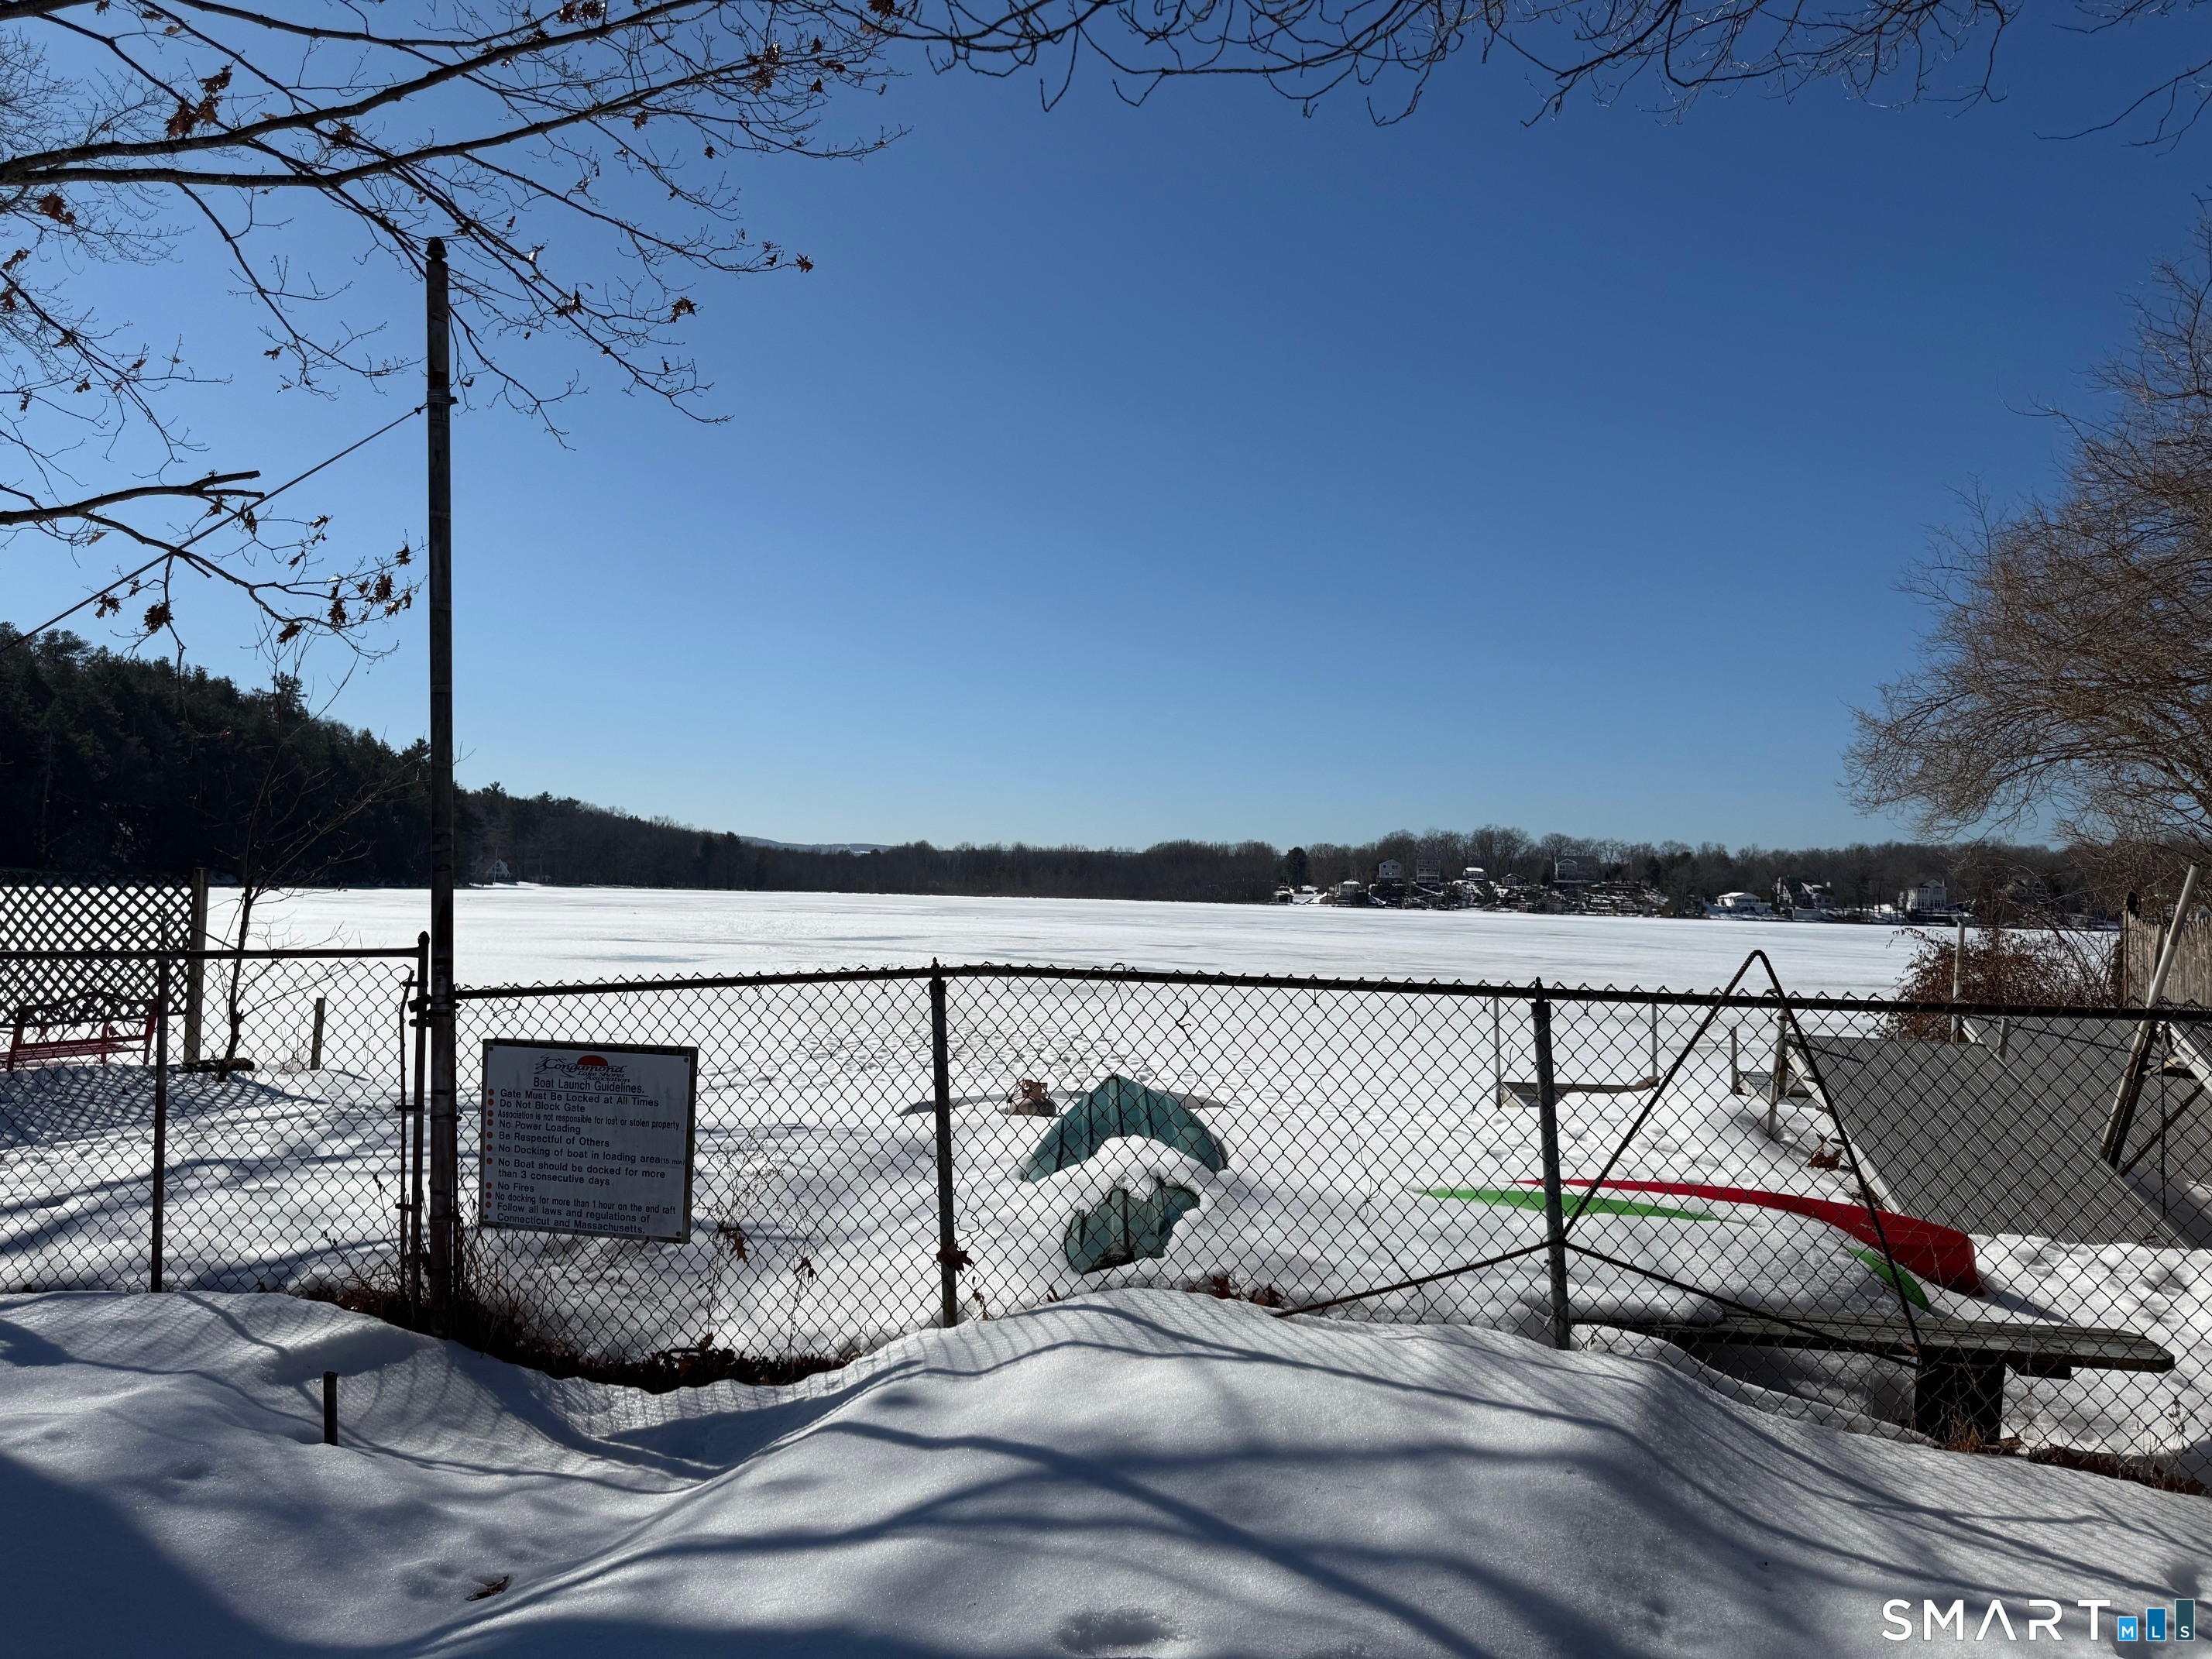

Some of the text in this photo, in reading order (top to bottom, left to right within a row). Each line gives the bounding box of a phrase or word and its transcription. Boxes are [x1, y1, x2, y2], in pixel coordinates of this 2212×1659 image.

[543, 1059, 627, 1073] Congamond
[534, 1077, 644, 1094] Boat Launch Guidelines.
[500, 1089, 521, 1099] Gate
[525, 1091, 547, 1100] Must
[566, 1094, 599, 1103] Locked
[604, 1095, 613, 1104] at
[617, 1096, 628, 1104] All
[632, 1097, 659, 1106] Times
[516, 1101, 531, 1109] Not
[535, 1101, 560, 1111] Block
[564, 1104, 586, 1112] Gate
[498, 1110, 533, 1119] Association
[556, 1114, 592, 1124] responsible
[594, 1115, 603, 1124] for
[606, 1117, 618, 1125] lost
[630, 1118, 649, 1128] stolen
[652, 1120, 679, 1130] property
[499, 1120, 581, 1135] No Power Loading
[499, 1132, 610, 1147] Be Respectful of Others
[499, 1144, 510, 1152] No
[514, 1146, 550, 1157] Docking
[555, 1148, 563, 1156] of
[567, 1149, 588, 1159] boat
[592, 1151, 599, 1159] in
[603, 1152, 636, 1163] loading
[499, 1158, 665, 1178] No Boat should be docked for more
[499, 1169, 610, 1186] than 3 consecutive days
[498, 1181, 534, 1192] No Fires
[496, 1192, 506, 1200] No
[507, 1194, 536, 1204] docking
[539, 1195, 549, 1204] for
[552, 1197, 571, 1206] more
[574, 1199, 589, 1207] than
[592, 1200, 596, 1208] 1
[598, 1200, 615, 1210] hour
[630, 1203, 643, 1211] the
[645, 1204, 659, 1213] end
[662, 1205, 675, 1214] raft
[498, 1203, 650, 1223] Follow all laws and regulations of
[497, 1213, 645, 1234] Connecticut and Massachusetts.
